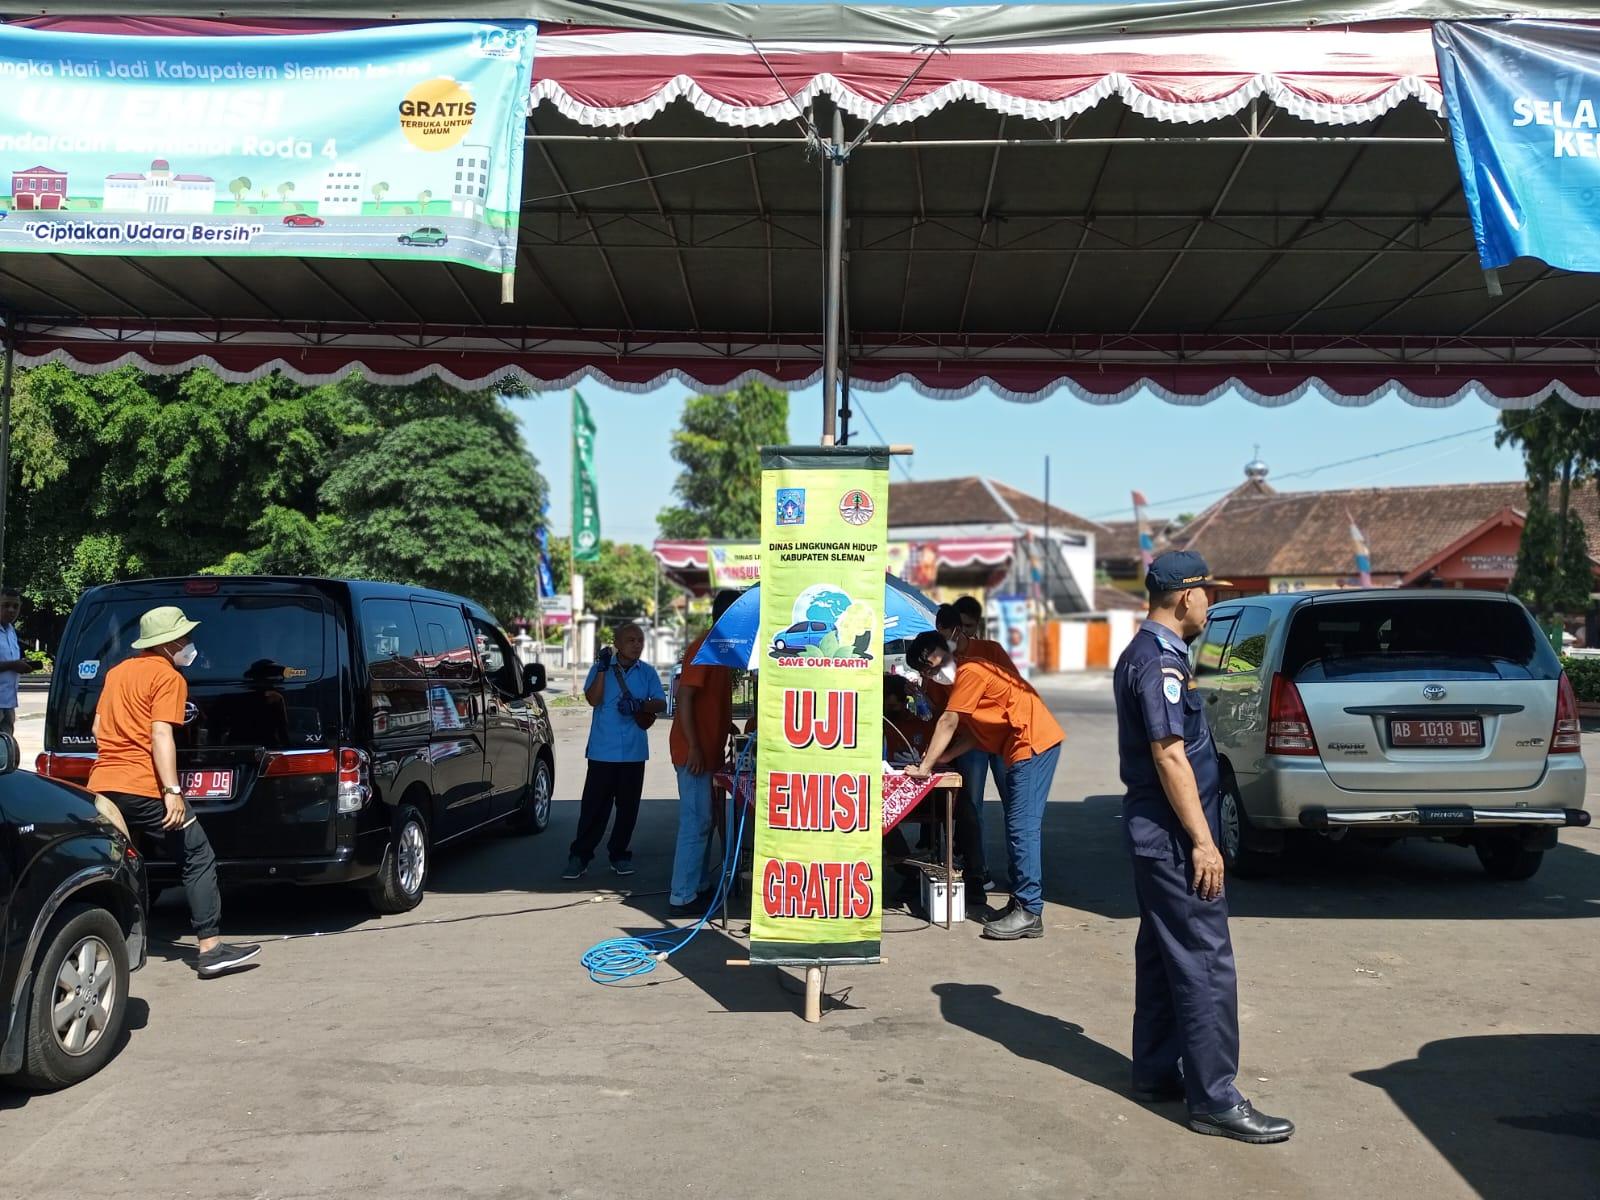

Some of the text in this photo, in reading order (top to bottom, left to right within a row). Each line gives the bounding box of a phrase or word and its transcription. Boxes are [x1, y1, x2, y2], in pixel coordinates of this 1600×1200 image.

[59, 59, 100, 78] Hari
[106, 60, 149, 78] Jadi
[155, 61, 278, 82] Kabupatern
[283, 62, 361, 80] Sleman
[399, 100, 477, 117] GRATIS
[400, 119, 473, 128] TERBUKA UNTUK
[423, 127, 450, 135] UMUM
[242, 135, 313, 159] Roda
[320, 138, 337, 159] 4
[127, 225, 185, 240] Udara
[769, 542, 878, 552] DINAS LINGKUNGAN HIDUP
[780, 553, 865, 562] KABUPATEN SLEMAN
[778, 658, 868, 668] SAVE OUR EARTH
[783, 688, 858, 750] UJI
[1395, 722, 1411, 737] AB
[1461, 721, 1478, 736] DE
[305, 734, 322, 742] XV
[212, 772, 230, 788] DE
[768, 772, 870, 833] EMISI
[762, 858, 873, 919] GRATIS
